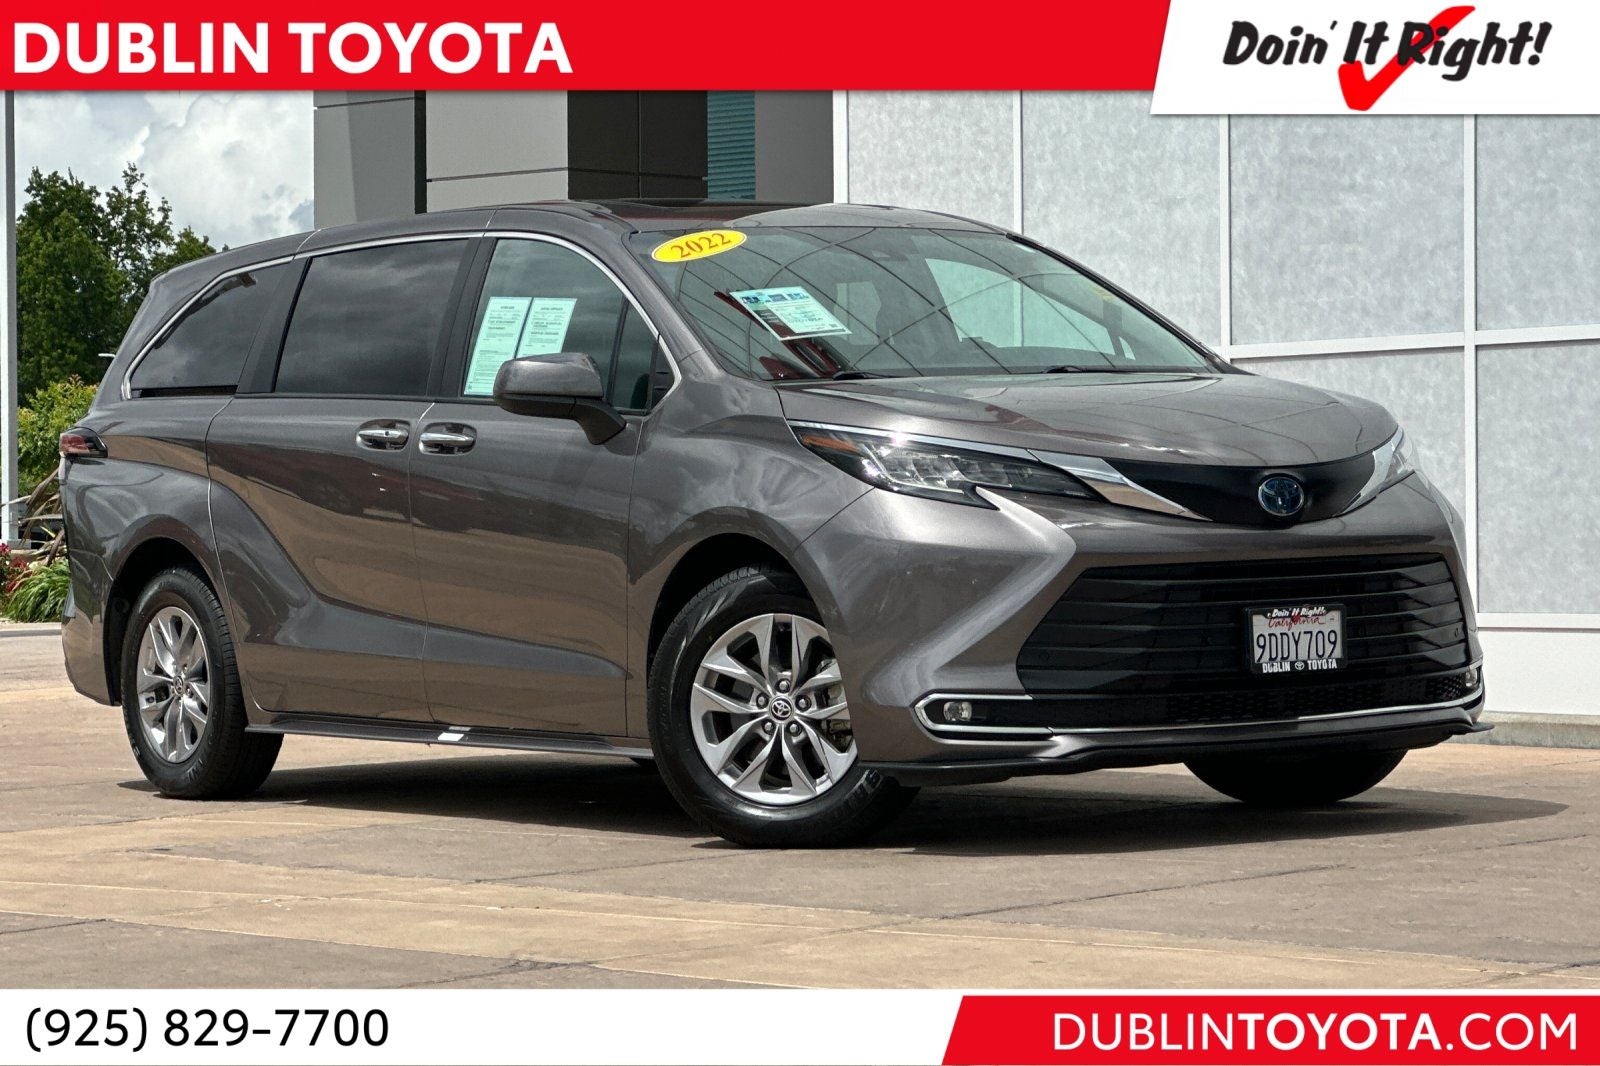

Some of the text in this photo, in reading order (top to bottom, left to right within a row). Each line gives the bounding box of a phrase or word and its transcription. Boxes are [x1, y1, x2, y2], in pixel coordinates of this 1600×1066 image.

[671, 233, 731, 258] 2022
[1256, 630, 1338, 662] 9DDY709
[1262, 659, 1337, 673] DUBLIN TOYOTA
